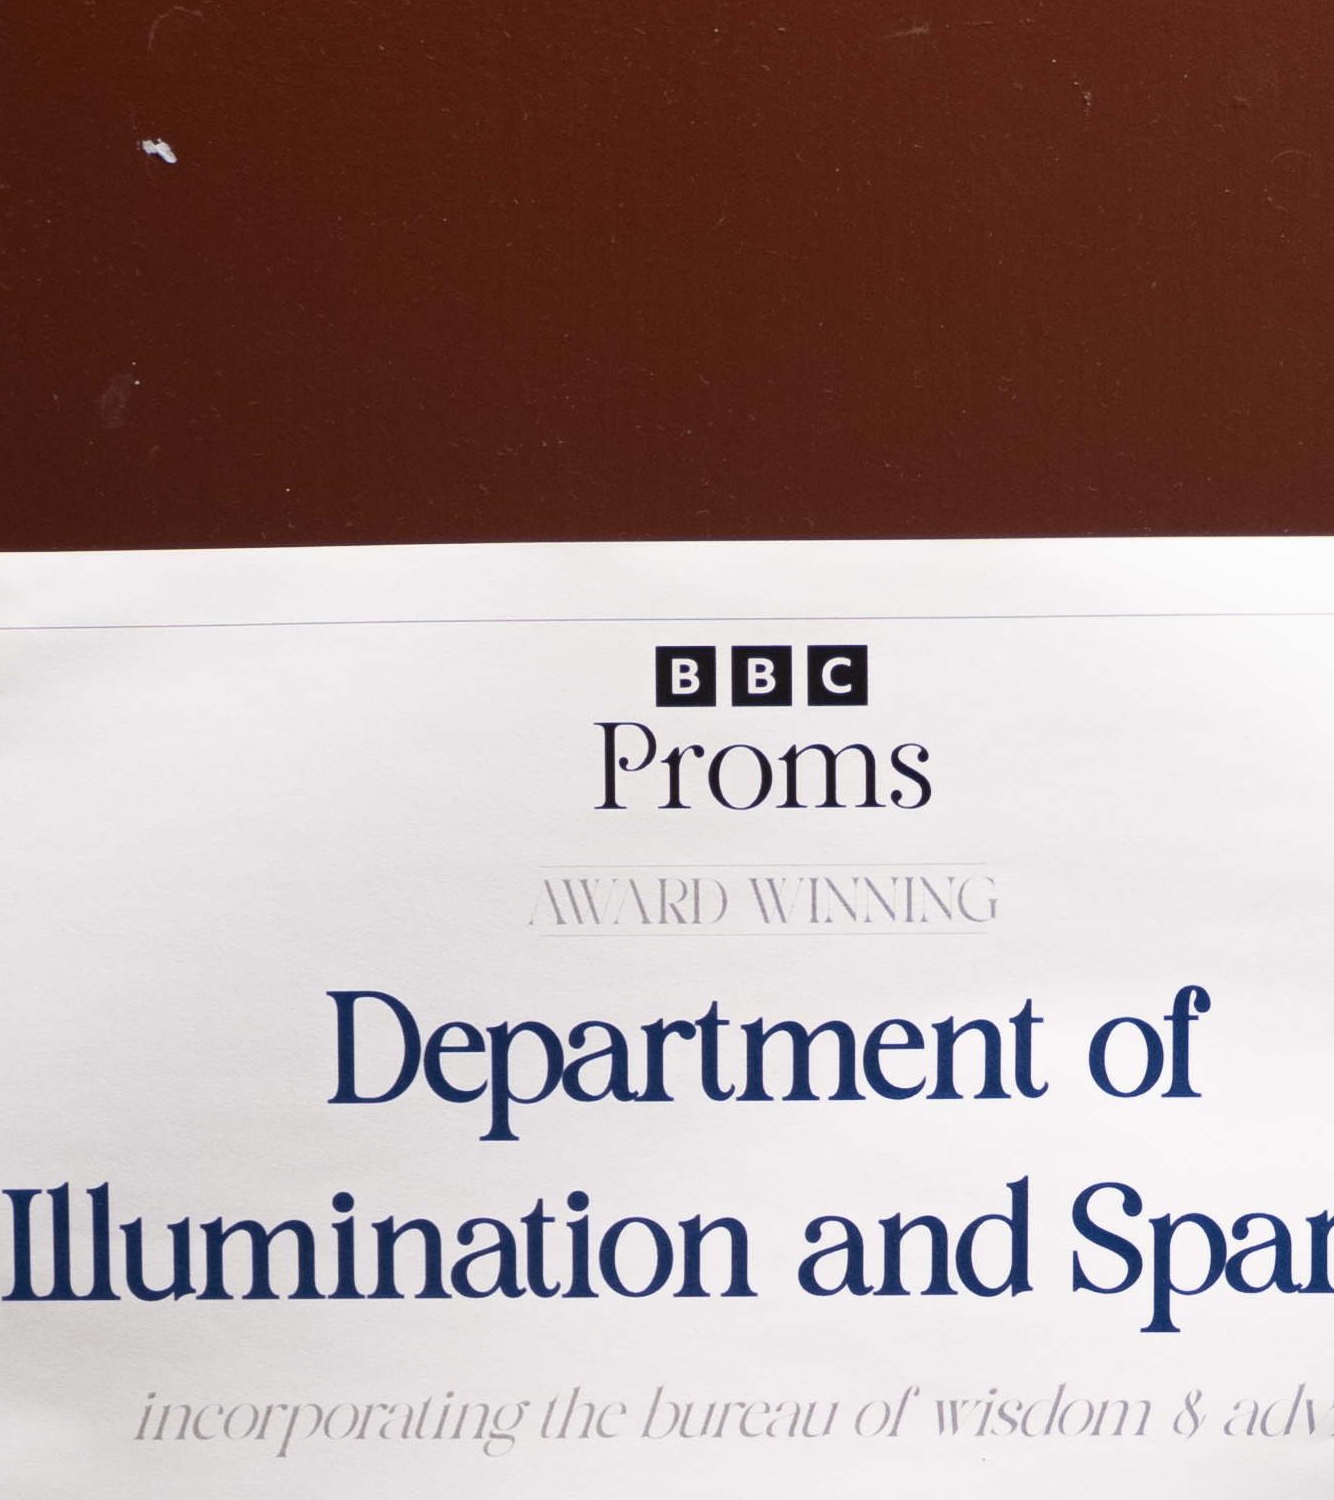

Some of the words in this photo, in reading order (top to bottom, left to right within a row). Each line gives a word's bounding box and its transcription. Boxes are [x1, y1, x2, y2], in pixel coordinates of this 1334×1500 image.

[666, 653, 857, 698] BBC
[593, 722, 932, 810] Proms
[527, 878, 728, 925] AWARD
[748, 876, 998, 924] WINNING
[326, 990, 1049, 1141] Department
[1088, 985, 1211, 1098] of
[1, 1181, 758, 1302] Illumination
[798, 1175, 1033, 1297] and
[131, 1391, 531, 1458] incorporating
[540, 1386, 627, 1439] the
[641, 1384, 840, 1439] bureau
[854, 1385, 920, 1437] of
[935, 1382, 1151, 1437] wisdom
[1173, 1389, 1206, 1440] &
